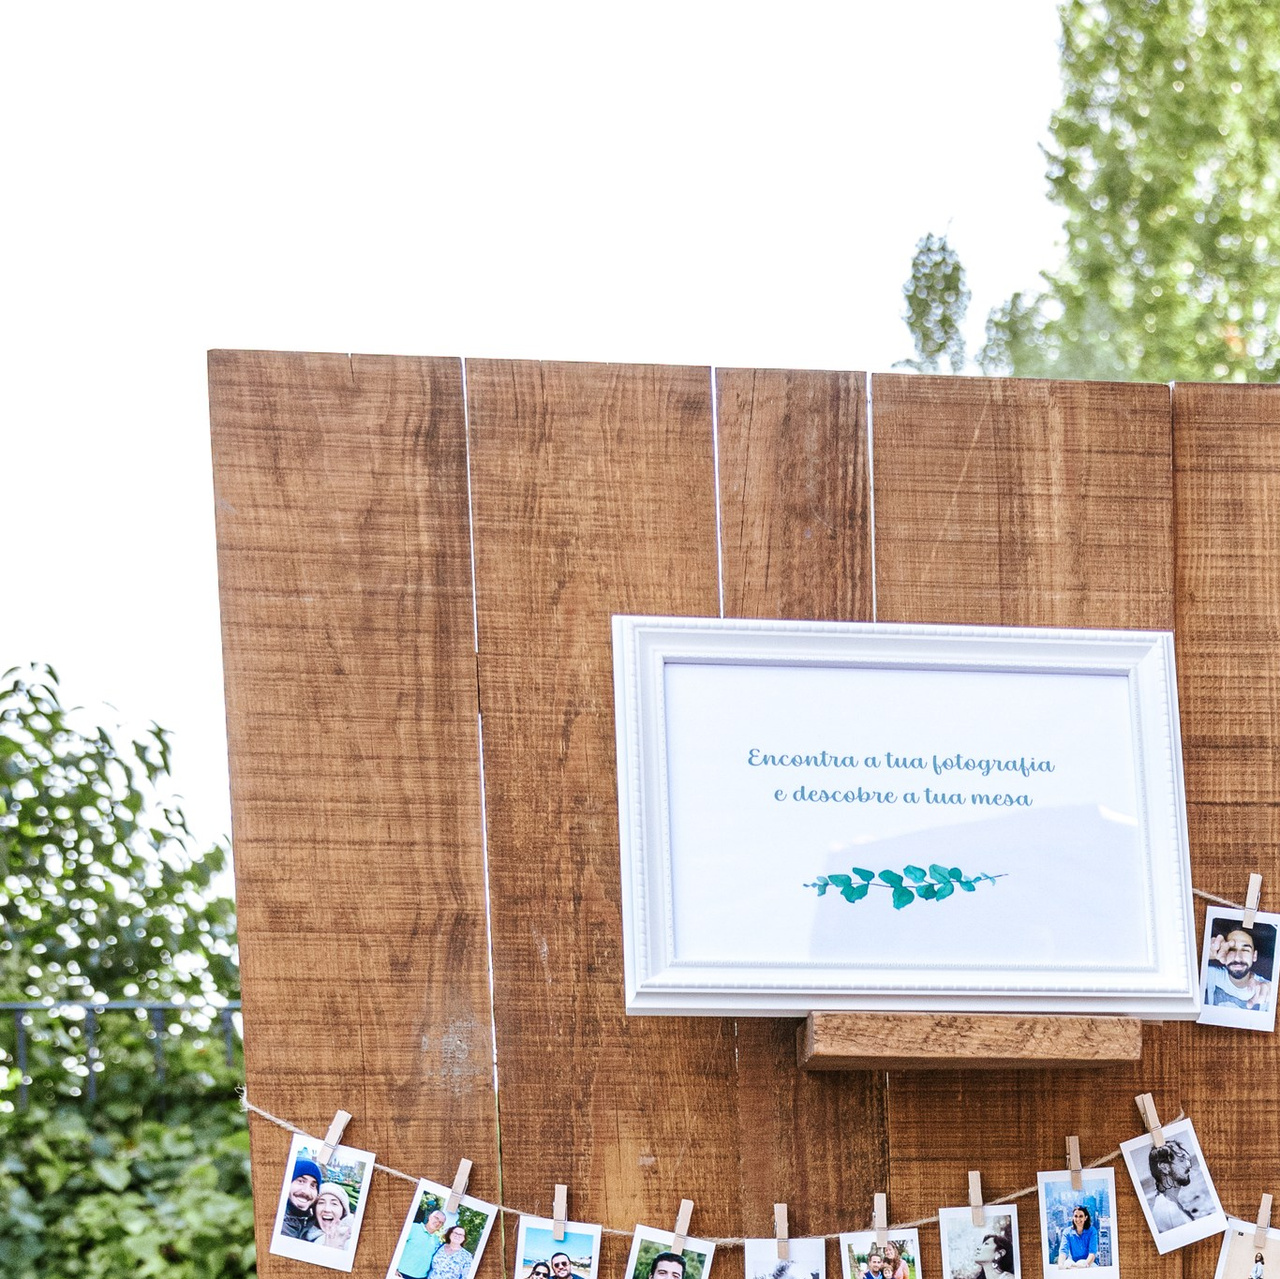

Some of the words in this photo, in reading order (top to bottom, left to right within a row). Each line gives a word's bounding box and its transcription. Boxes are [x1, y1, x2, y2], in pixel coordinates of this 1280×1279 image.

[747, 748, 860, 768] Encontra
[863, 756, 882, 769] a
[884, 751, 928, 770] tua
[932, 753, 1056, 777] fotografia
[773, 789, 788, 802] e
[792, 785, 899, 804] descobre
[902, 791, 921, 804] a
[923, 787, 967, 805] tua
[970, 793, 1034, 807] mesa
